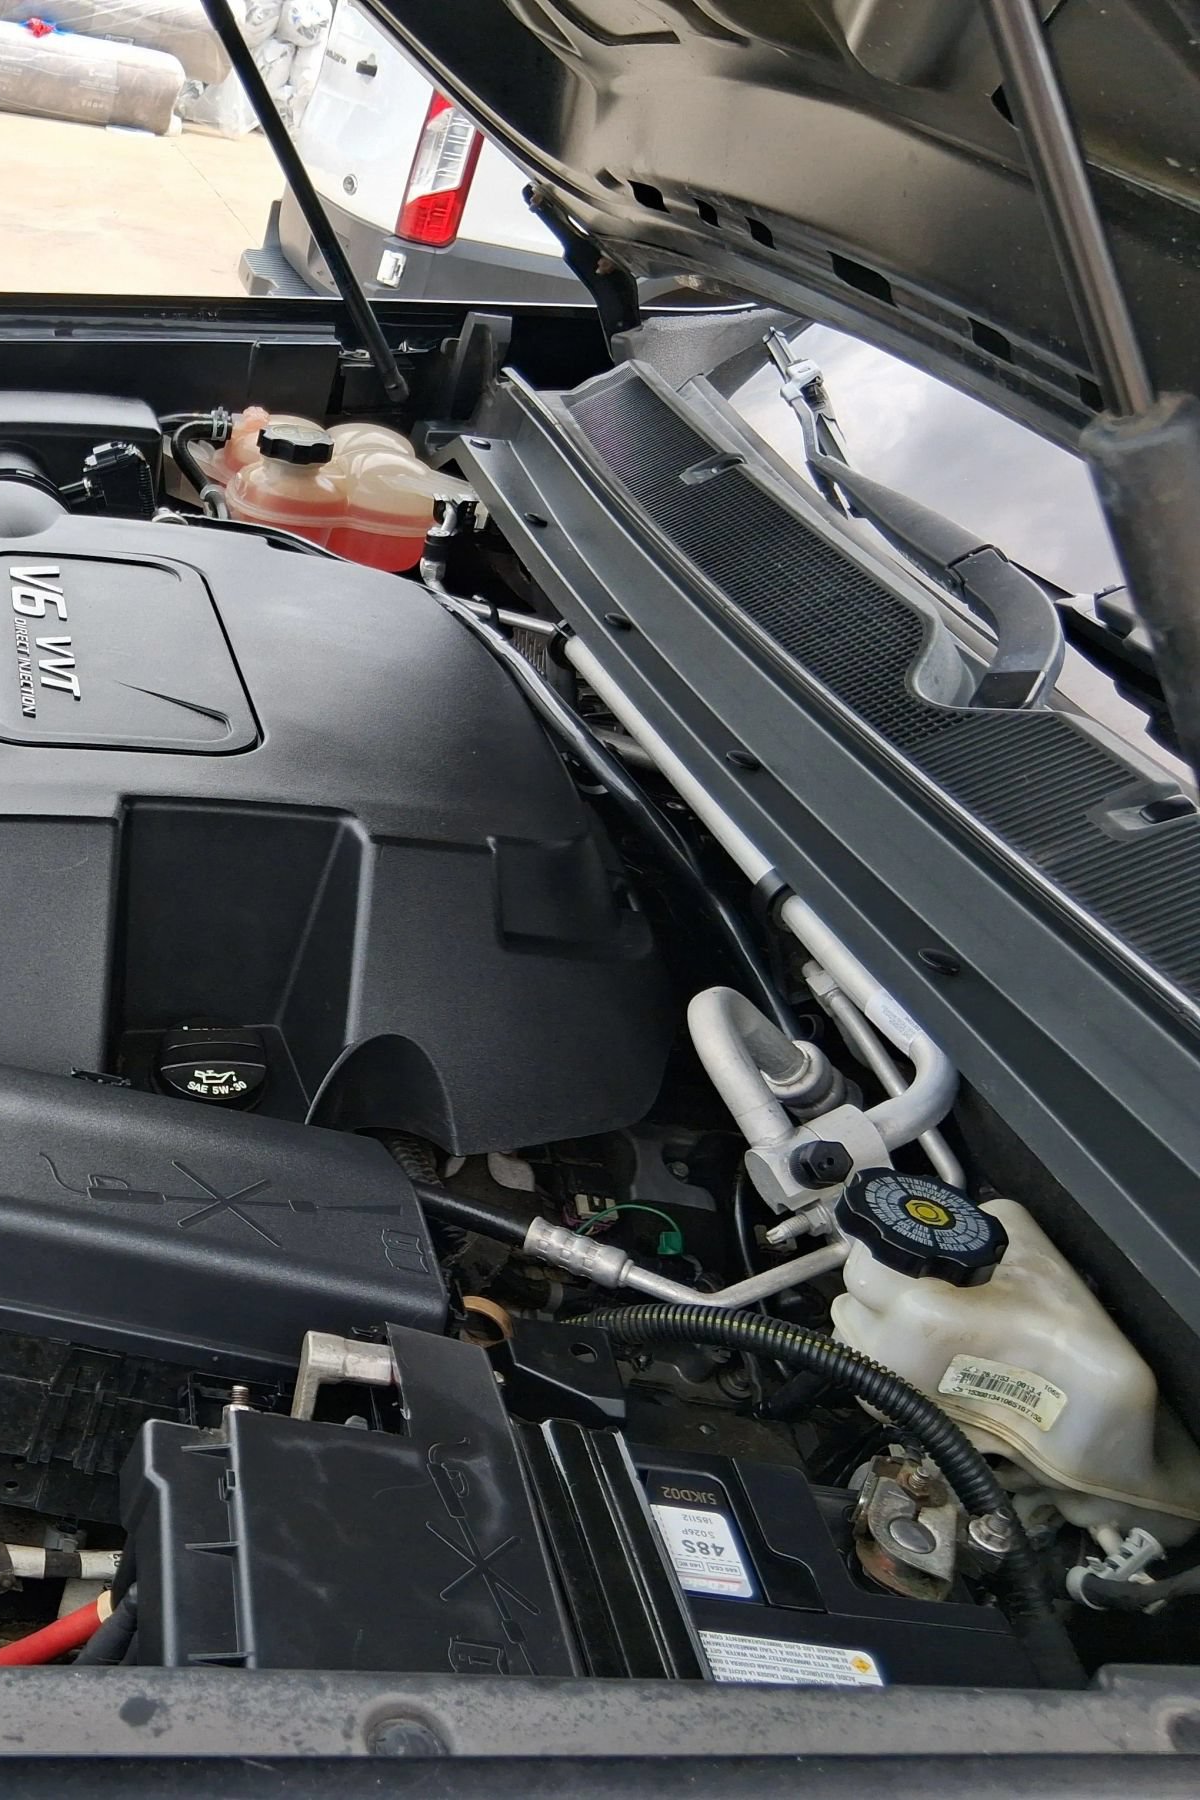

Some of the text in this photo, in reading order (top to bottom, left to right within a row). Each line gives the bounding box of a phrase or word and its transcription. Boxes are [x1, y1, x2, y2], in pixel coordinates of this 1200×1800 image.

[9, 565, 81, 701] V6 VVT
[14, 617, 36, 718] DIRECT INJECTION
[187, 1081, 247, 1094] SAE 5W-30
[682, 1540, 724, 1557] 48S
